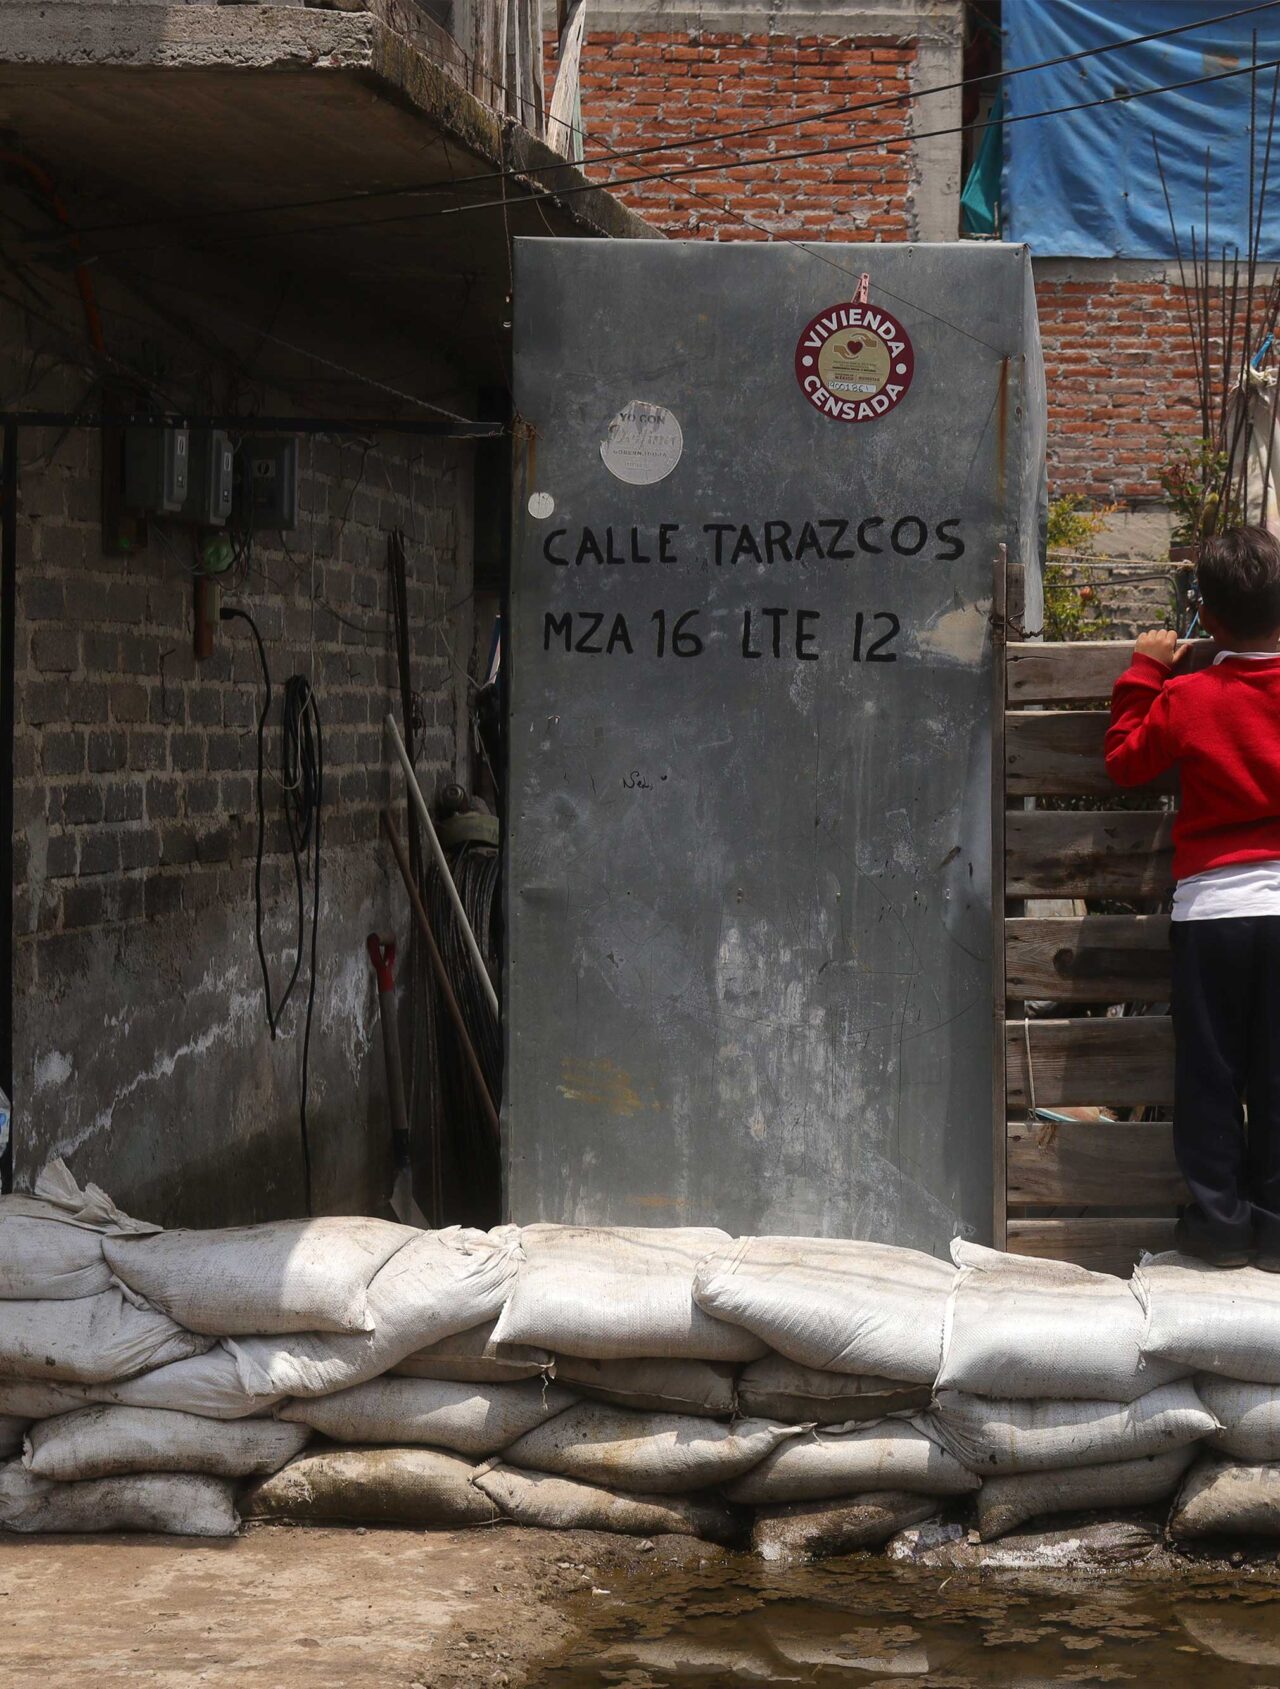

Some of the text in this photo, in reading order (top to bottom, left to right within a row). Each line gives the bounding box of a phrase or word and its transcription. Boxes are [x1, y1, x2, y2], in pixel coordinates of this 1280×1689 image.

[804, 308, 906, 358] VIVIENDA
[639, 414, 666, 425] CON
[804, 375, 904, 420] CENSADA
[543, 515, 965, 566] CALLE TARAZCOS
[543, 607, 901, 663] MZA 16 LTE 12
